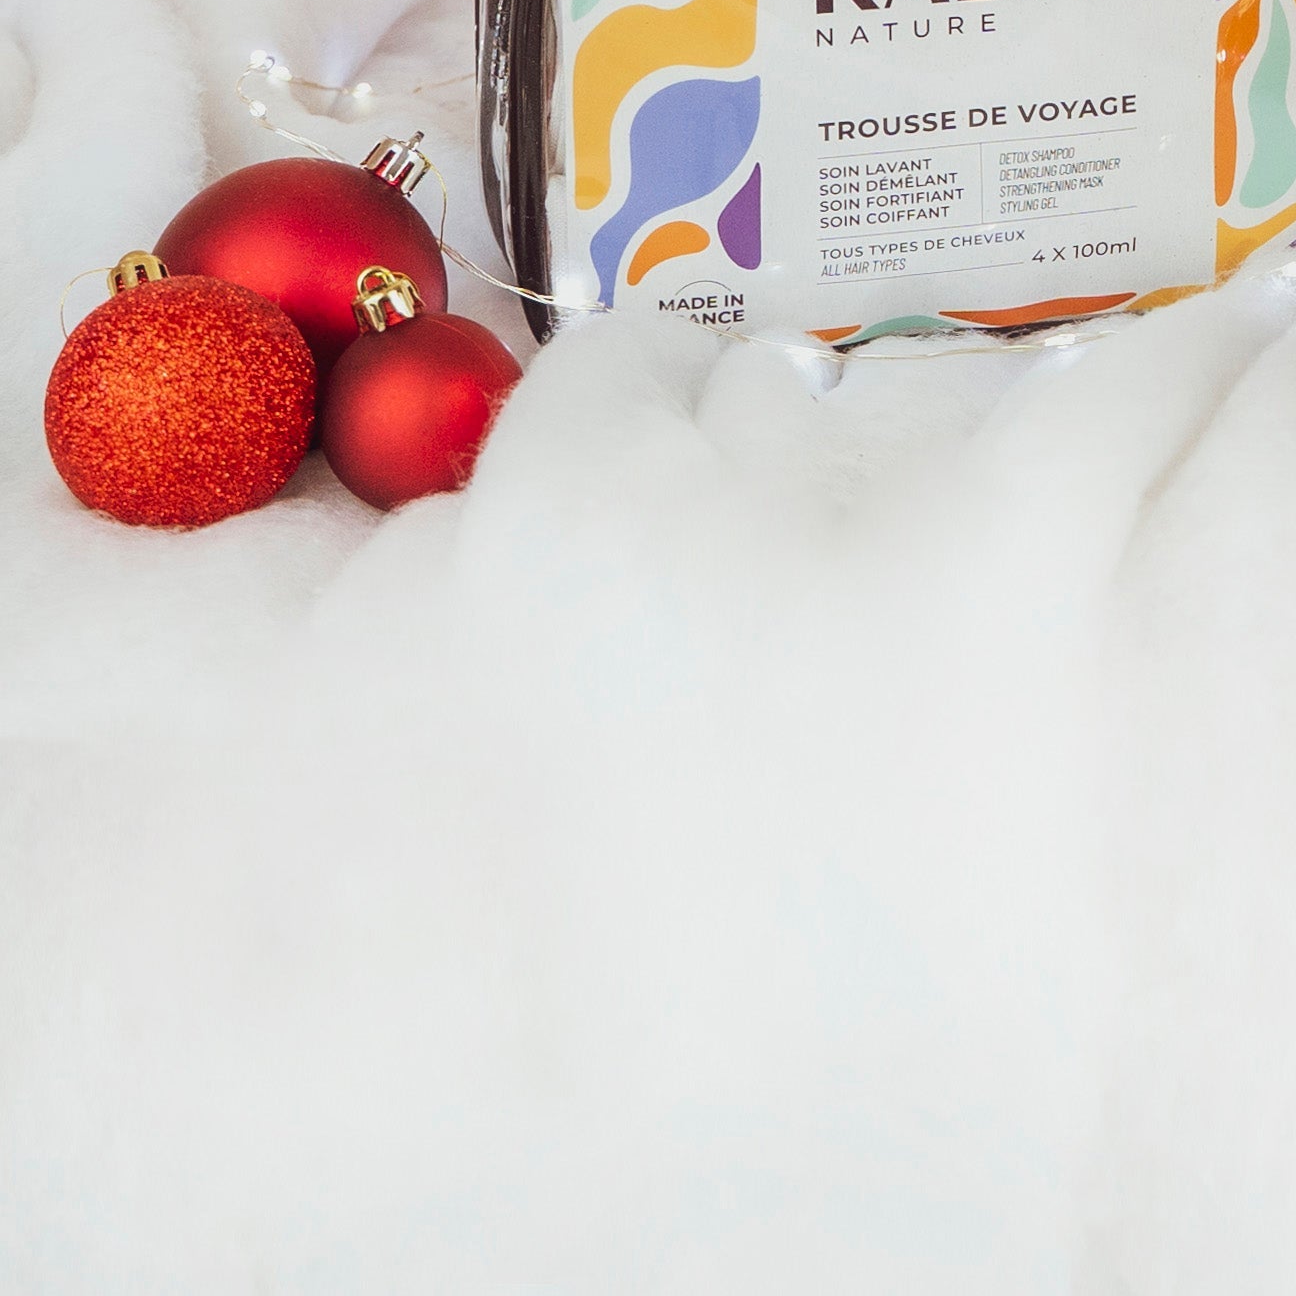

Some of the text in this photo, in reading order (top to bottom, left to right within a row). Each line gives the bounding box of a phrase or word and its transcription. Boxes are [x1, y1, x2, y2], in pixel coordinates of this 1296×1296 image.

[816, 14, 996, 47] NATURE
[819, 95, 1136, 141] TROUSSE DE VOYAGE
[999, 147, 1074, 165] DETOX SHAMPOO
[819, 159, 932, 180] SOIN LAVANT
[999, 158, 1121, 181] DETANGLING CONDITIONER
[820, 172, 957, 196] SOIN DÉMÊLANT
[1000, 175, 1104, 197] STRENGTHENING MASK
[820, 188, 964, 212] SOIN FORTIFIANT
[1000, 198, 1058, 214] STYLING GEL
[820, 206, 950, 228] SOIN COIFFANT
[820, 230, 1026, 260] TOUS TYPES DE CHEVEUX
[1032, 237, 1136, 263] 4 X 100ml
[821, 259, 906, 276] ALL HAIR TYPES
[659, 294, 744, 311] MADE IN
